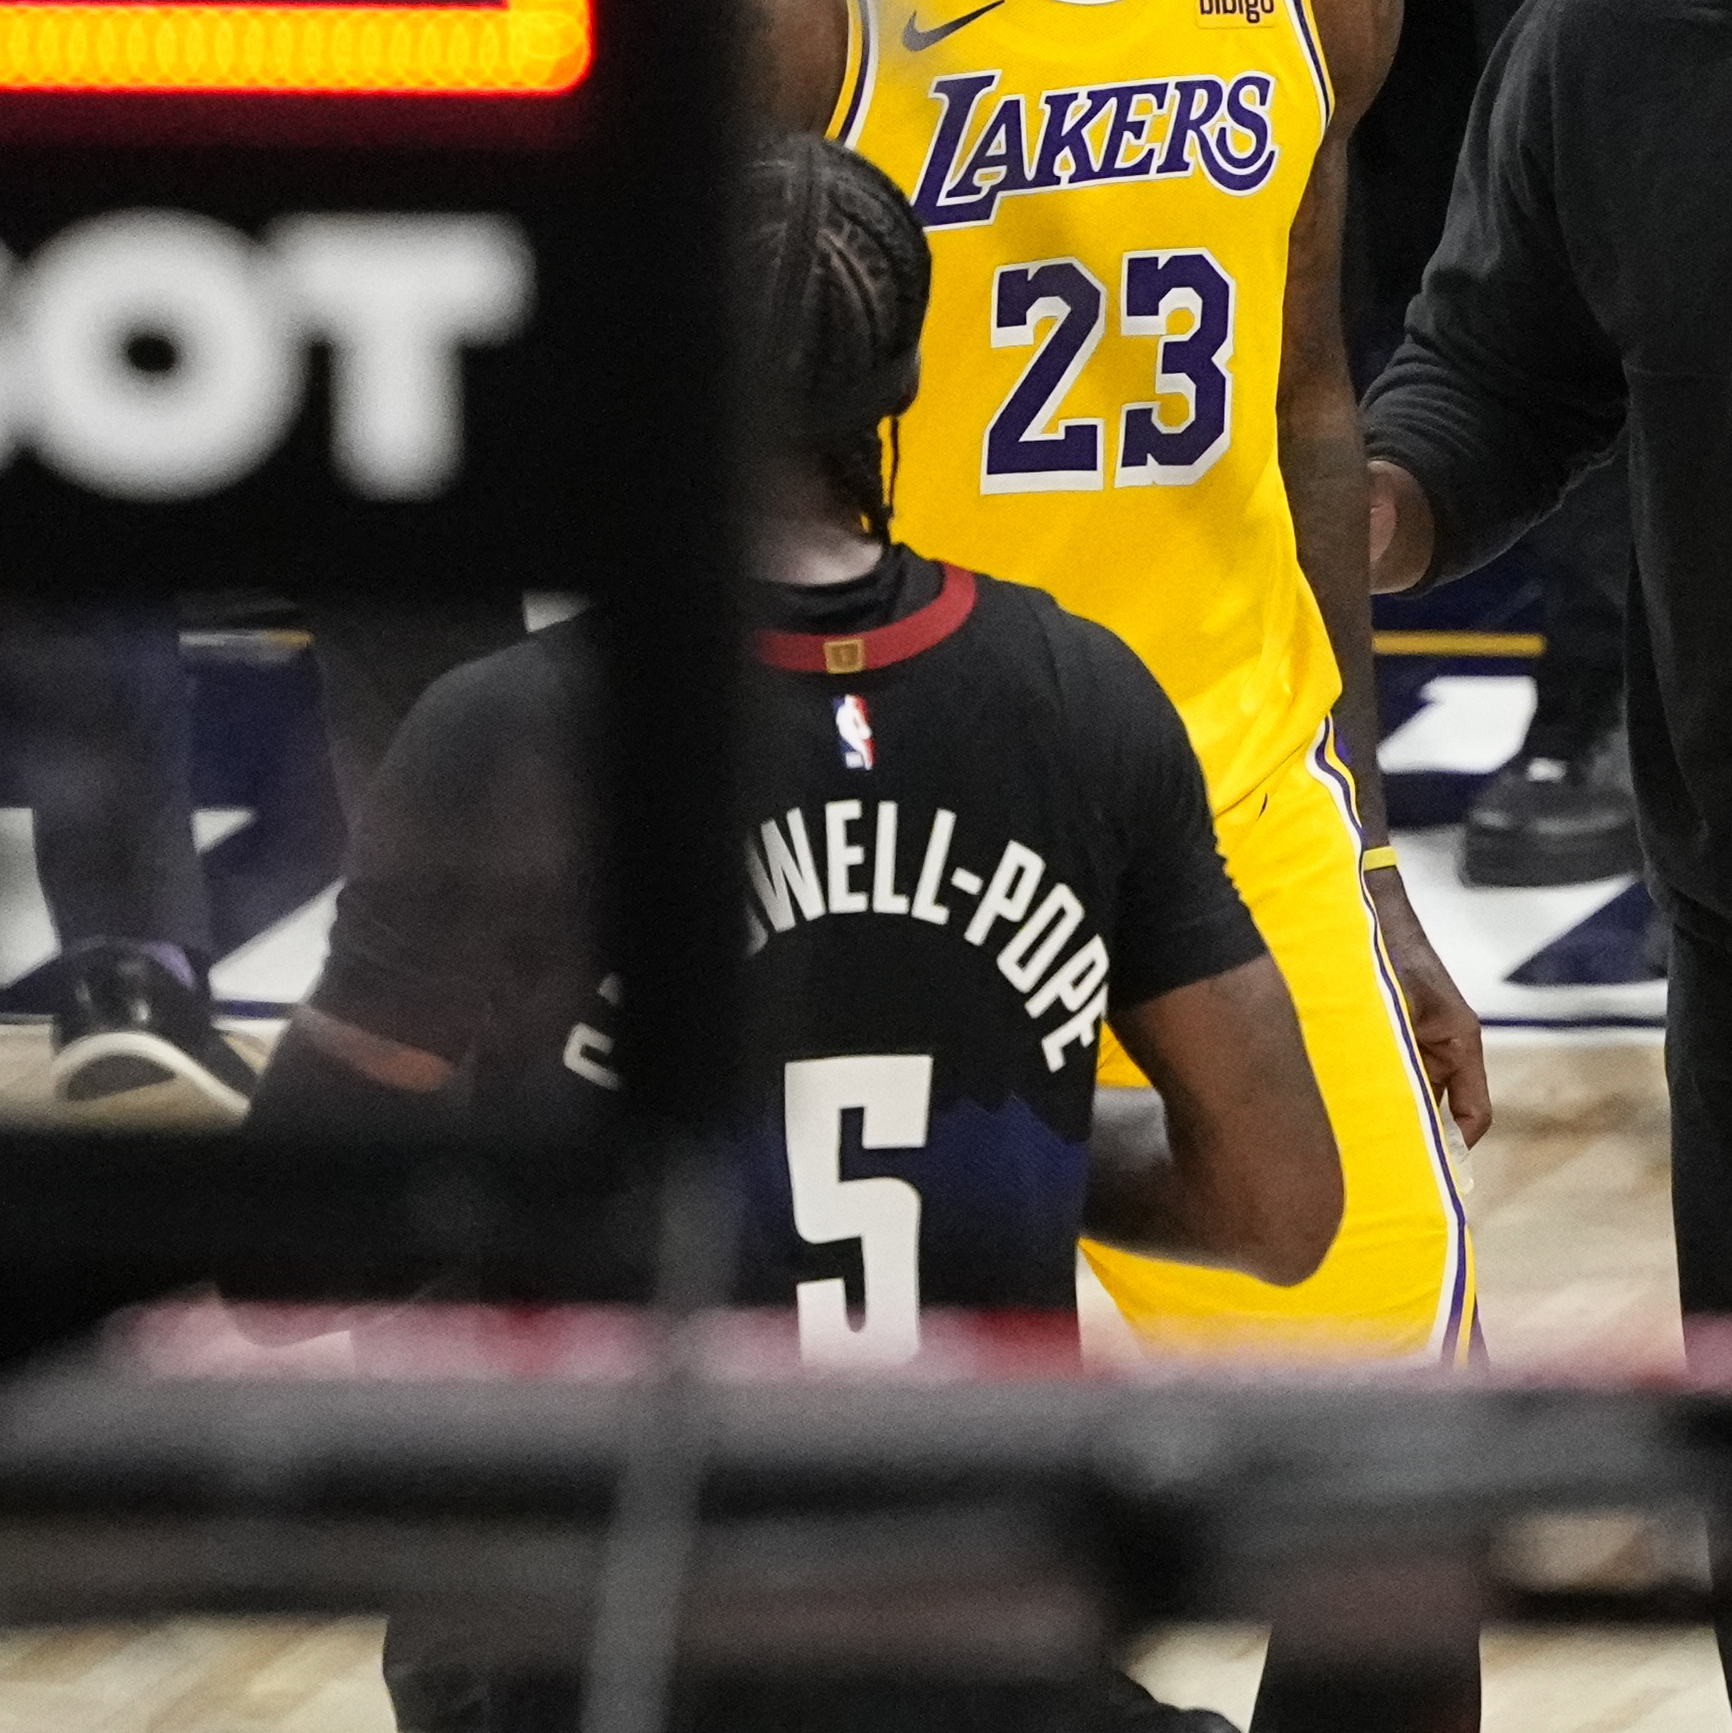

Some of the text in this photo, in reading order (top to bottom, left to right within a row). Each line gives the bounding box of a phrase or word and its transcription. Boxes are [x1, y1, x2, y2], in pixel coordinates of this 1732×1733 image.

[910, 70, 1279, 232] LAKERS
[979, 246, 1238, 496] 23
[784, 1054, 934, 1364] 5
